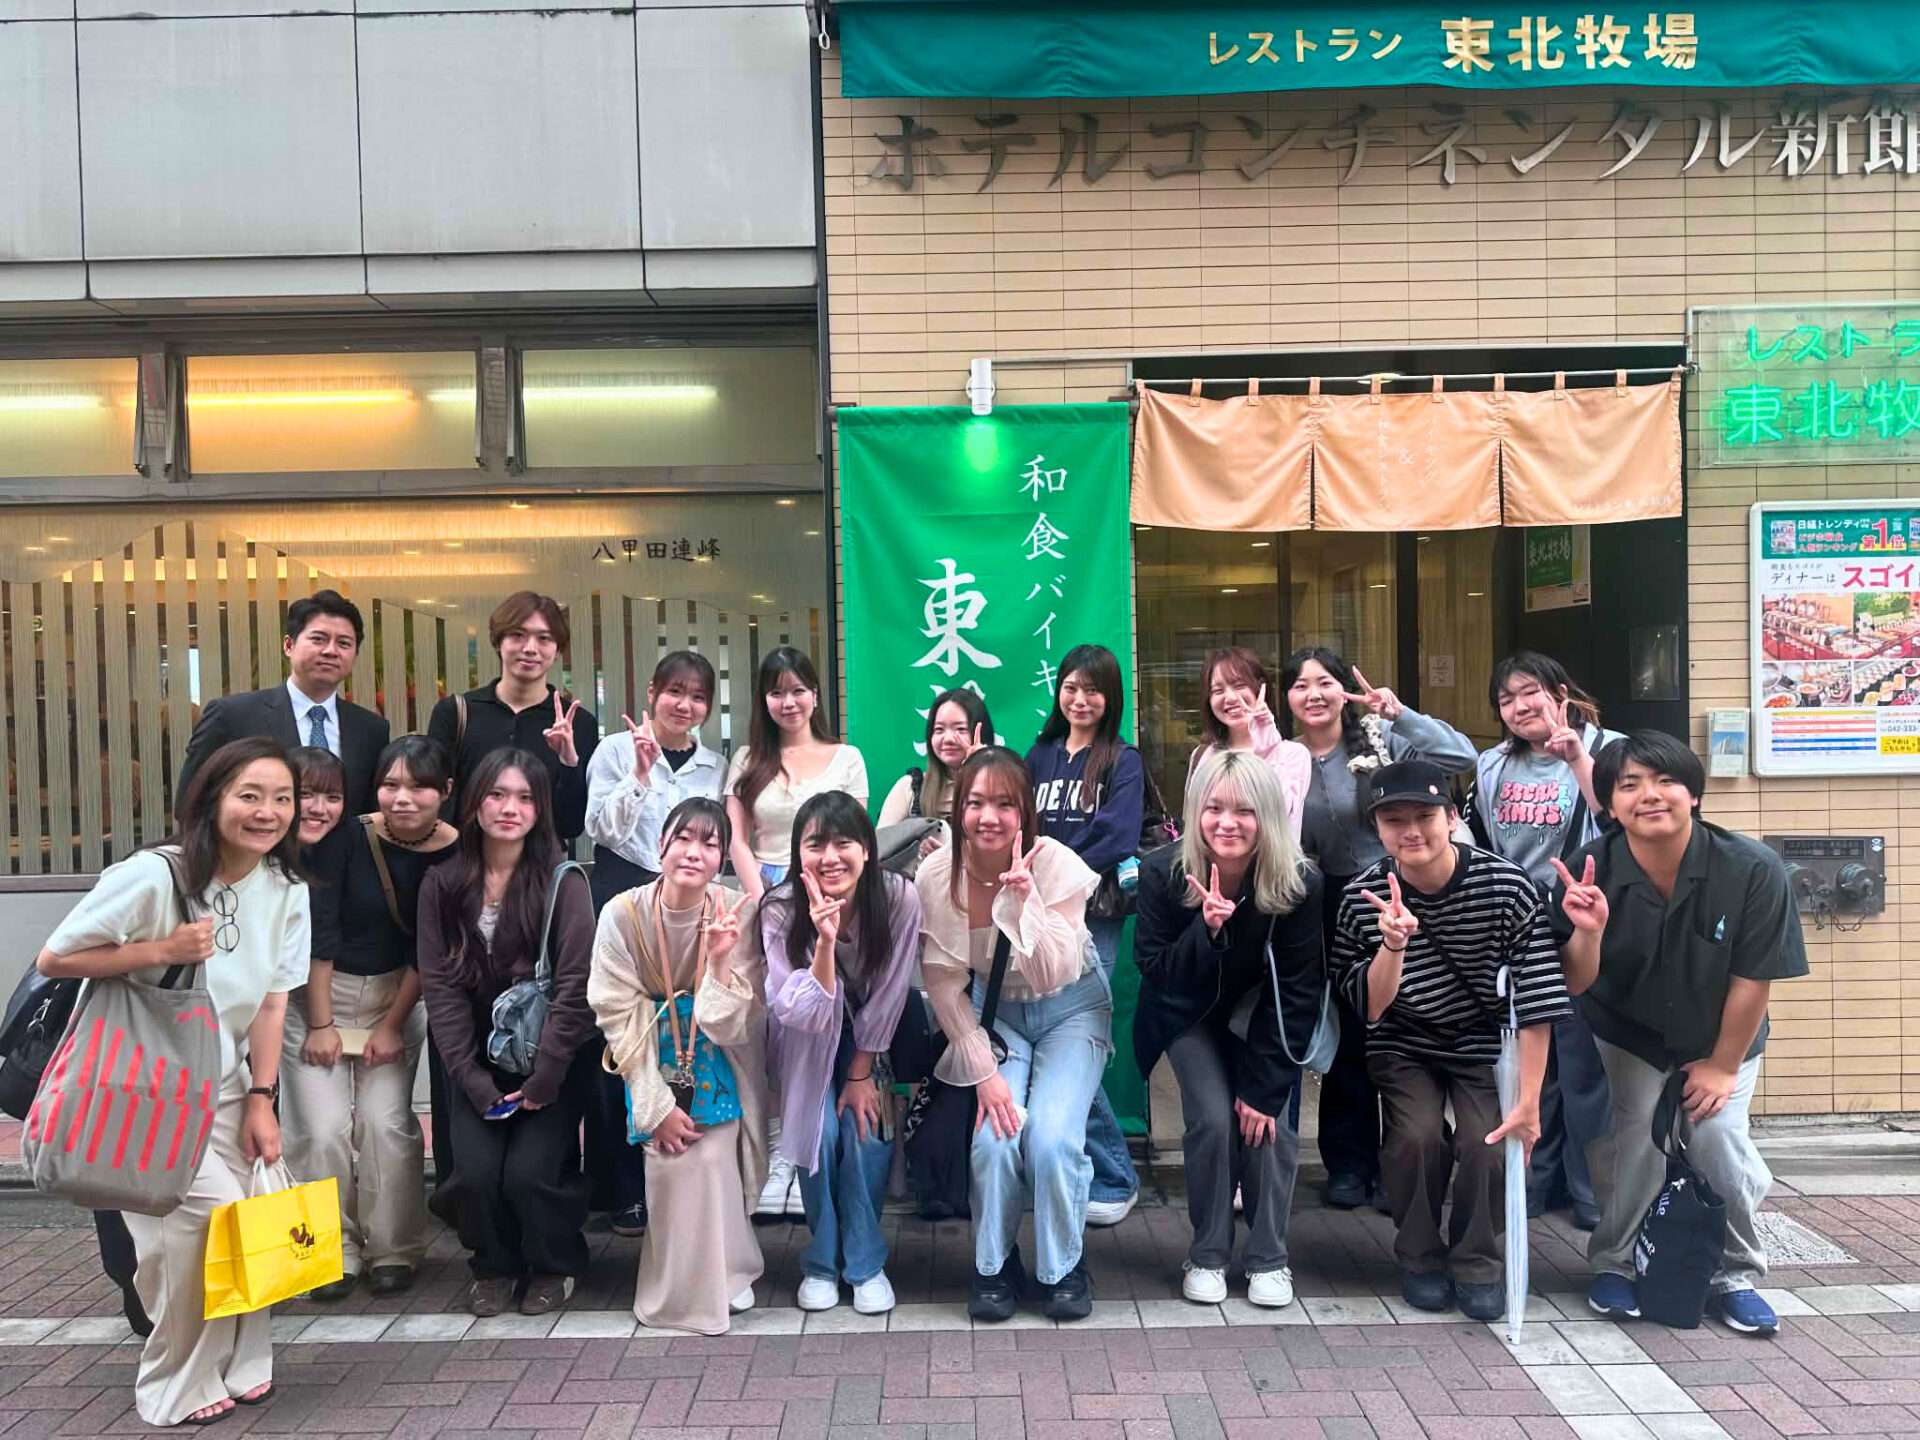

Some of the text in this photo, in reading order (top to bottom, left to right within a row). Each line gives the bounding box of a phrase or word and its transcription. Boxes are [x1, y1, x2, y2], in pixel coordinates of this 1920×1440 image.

[1209, 13, 1698, 73] レストラン 東北牧場
[1724, 378, 1920, 444] 東北牧
[592, 537, 721, 562] 八甲田連峰
[1770, 571, 1836, 585] ディナーは
[1842, 563, 1915, 588] スゴイ
[1500, 780, 1560, 803] BREAK
